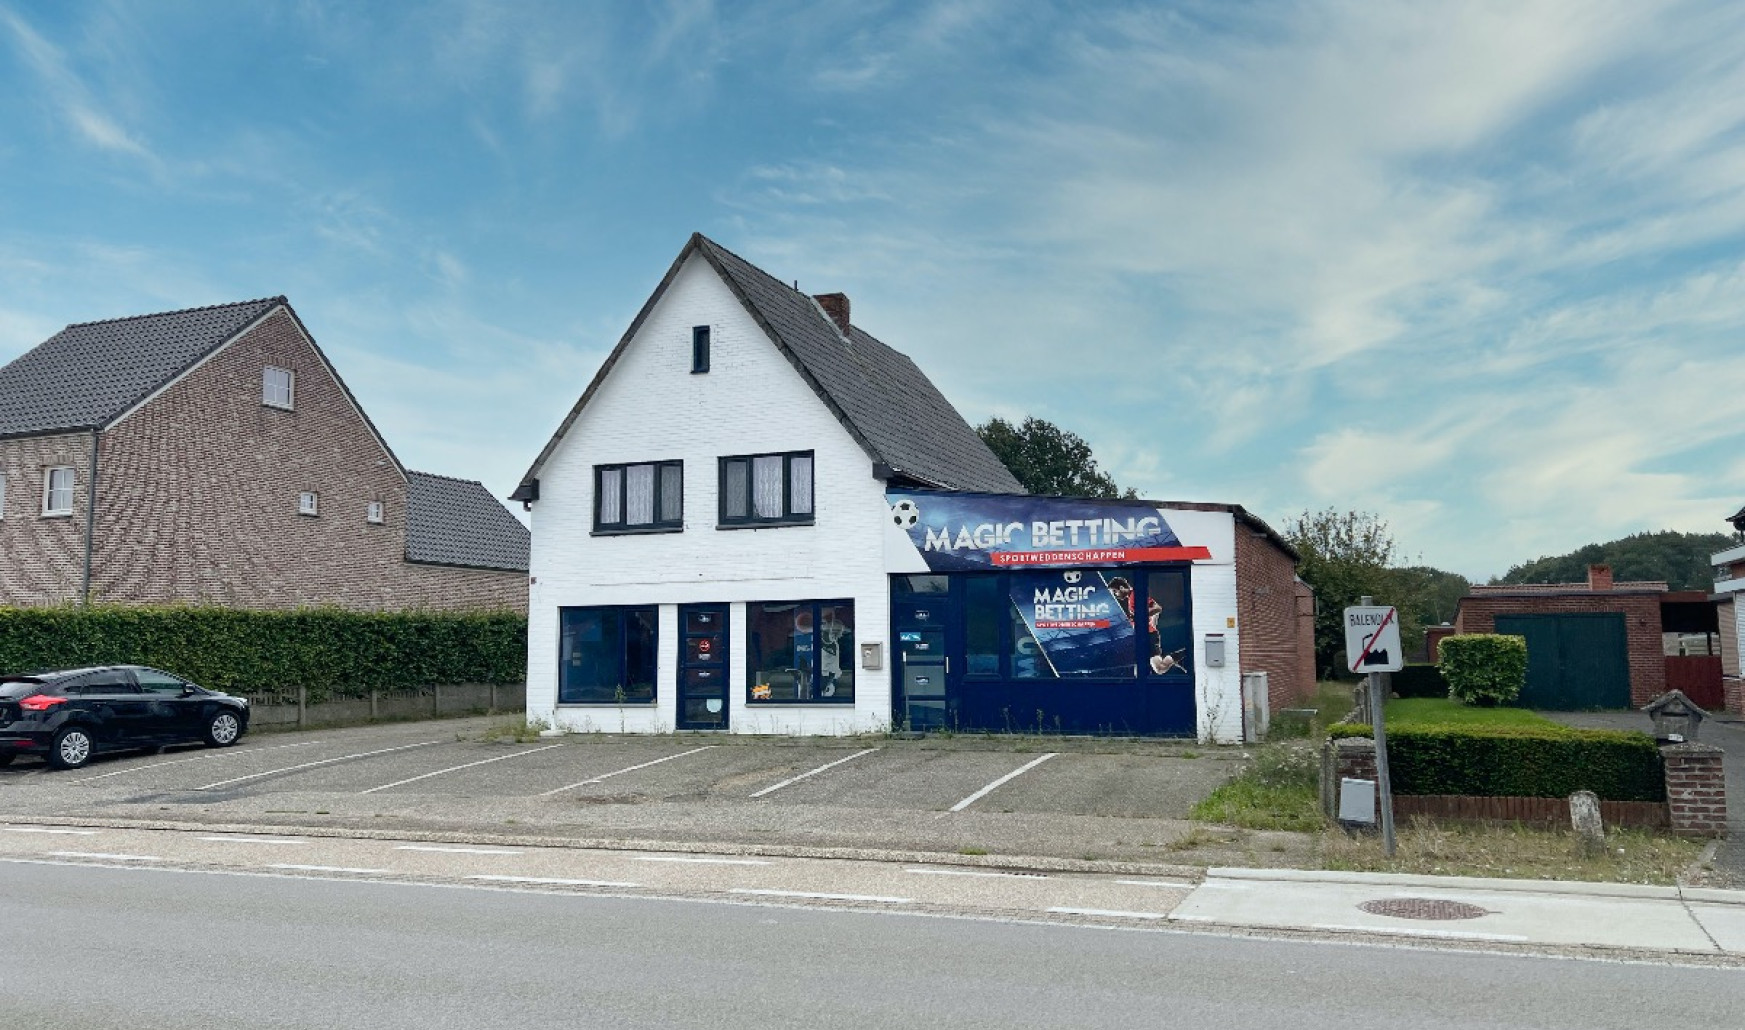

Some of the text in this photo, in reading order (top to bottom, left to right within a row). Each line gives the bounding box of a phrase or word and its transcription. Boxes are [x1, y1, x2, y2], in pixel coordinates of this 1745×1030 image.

[924, 517, 1161, 551] MAGIC BETTING
[999, 551, 1126, 563] SPORTWEDDENSCHAPPEN
[1033, 586, 1096, 604] MAGIC
[1035, 602, 1110, 620] BETTING
